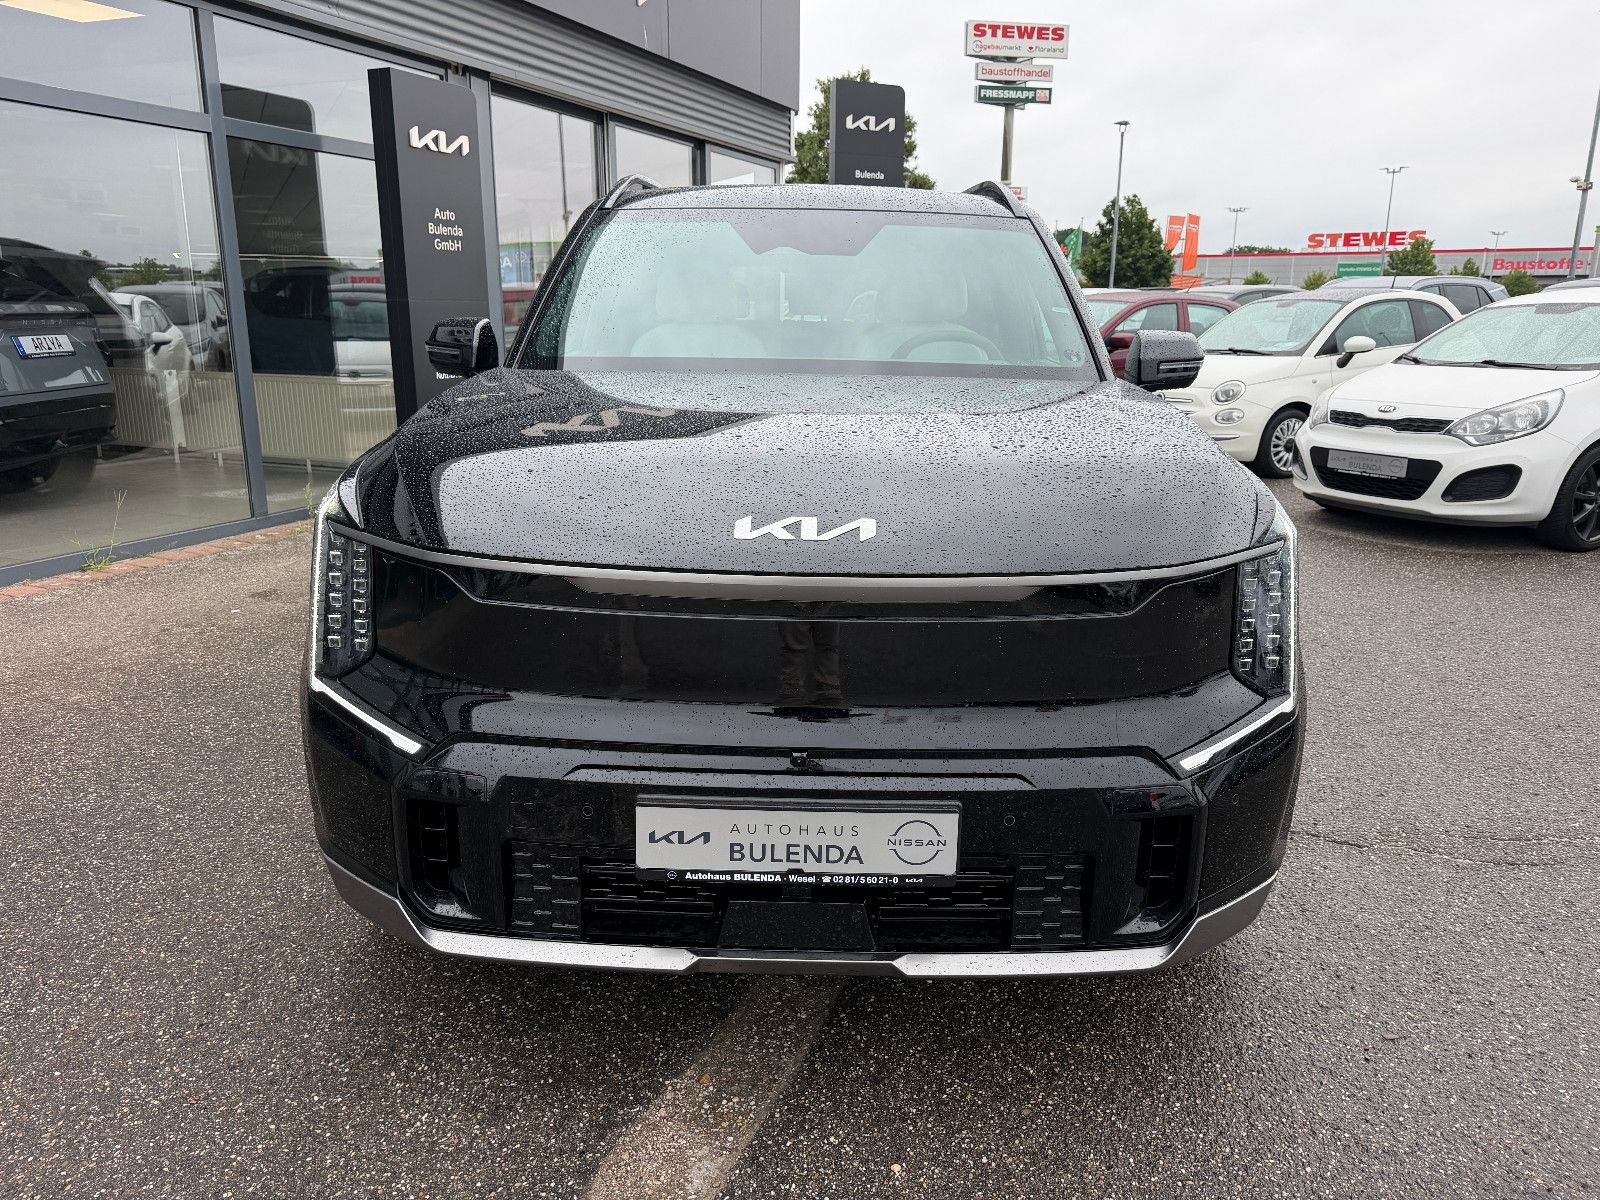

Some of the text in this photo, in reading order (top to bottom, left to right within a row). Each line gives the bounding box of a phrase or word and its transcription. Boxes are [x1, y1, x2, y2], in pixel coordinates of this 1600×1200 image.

[973, 23, 1065, 41] STEWES
[975, 43, 1022, 52] hagebaumarkt
[981, 66, 1051, 78] baustoffhandel
[980, 88, 1036, 100] FRESSNAPF
[845, 113, 896, 133] KIA
[409, 125, 470, 157] KIA
[855, 169, 885, 180] Bulenda
[434, 207, 456, 221] Auto
[428, 222, 464, 237] Bulenda
[434, 238, 462, 252] GmbH
[1307, 230, 1427, 249] STEWES
[734, 515, 877, 542] KIA
[729, 823, 860, 837] AUTOHAUS
[648, 830, 711, 845] KIA
[887, 838, 947, 847] NISSAN
[729, 842, 865, 865] BULENDA
[685, 871, 731, 882] Autohaus
[733, 873, 782, 883] BULENDA
[789, 875, 816, 884] Wesel
